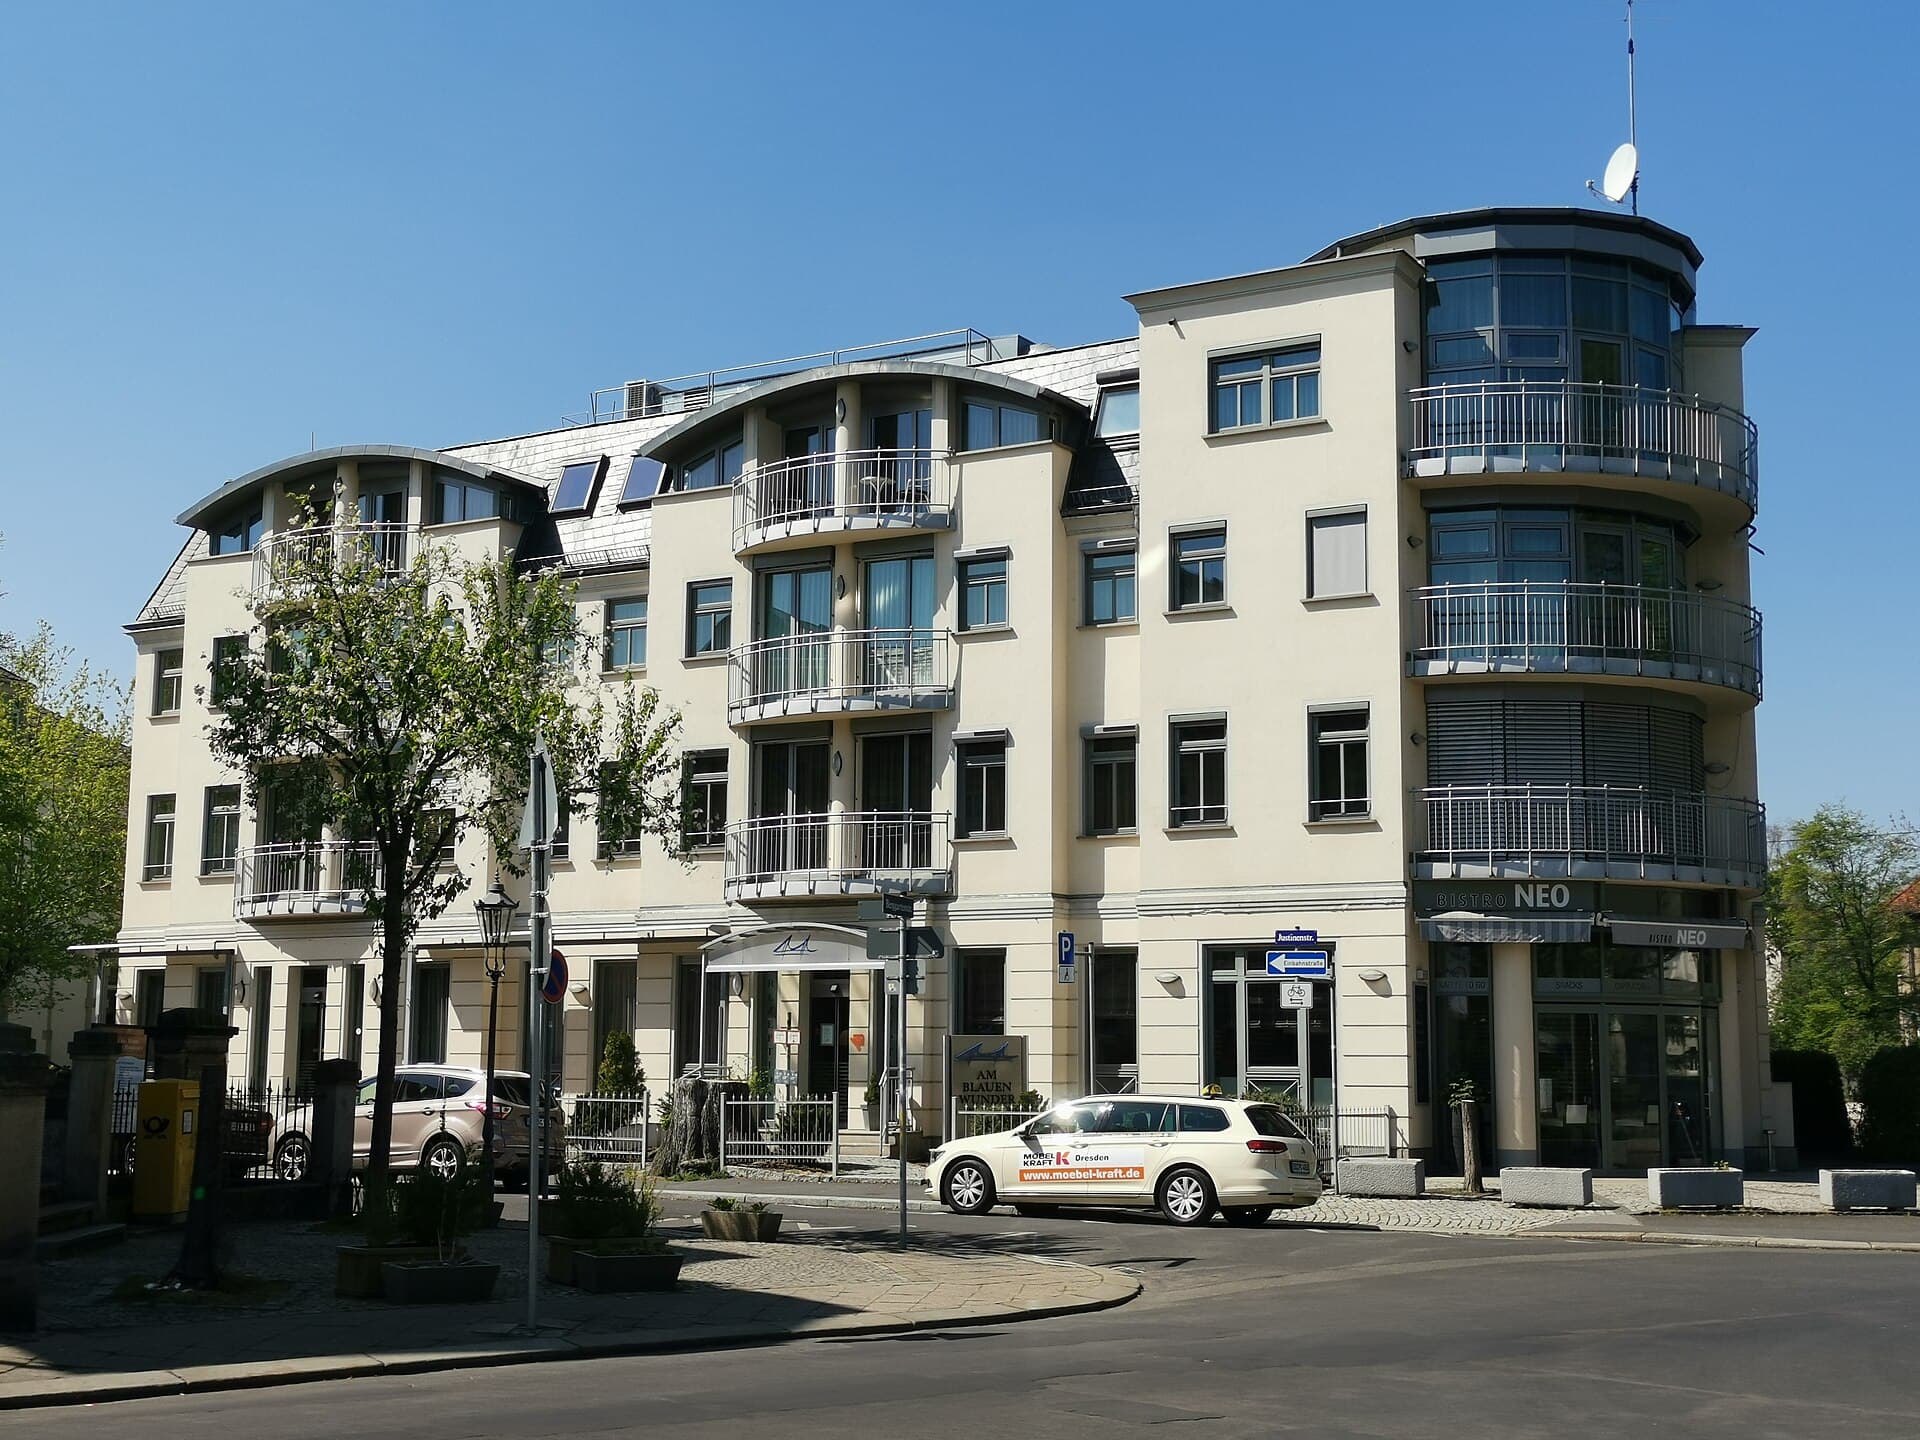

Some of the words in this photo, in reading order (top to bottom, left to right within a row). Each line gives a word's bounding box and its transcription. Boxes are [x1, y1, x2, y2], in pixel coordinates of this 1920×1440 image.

[1436, 892, 1507, 908] BISTRO
[1514, 883, 1570, 908] NEO
[1277, 932, 1315, 942] Justinenstr.
[1676, 929, 1707, 945] NEO
[1061, 936, 1071, 961] P
[1283, 959, 1324, 967] Einbahnstraße
[976, 1069, 998, 1080] AM
[962, 1081, 1012, 1093] BLAUEN
[959, 1093, 1016, 1105] WUNDER
[1075, 1154, 1109, 1162] Dresden
[1023, 1168, 1140, 1180] www.moebel-kraft.de
